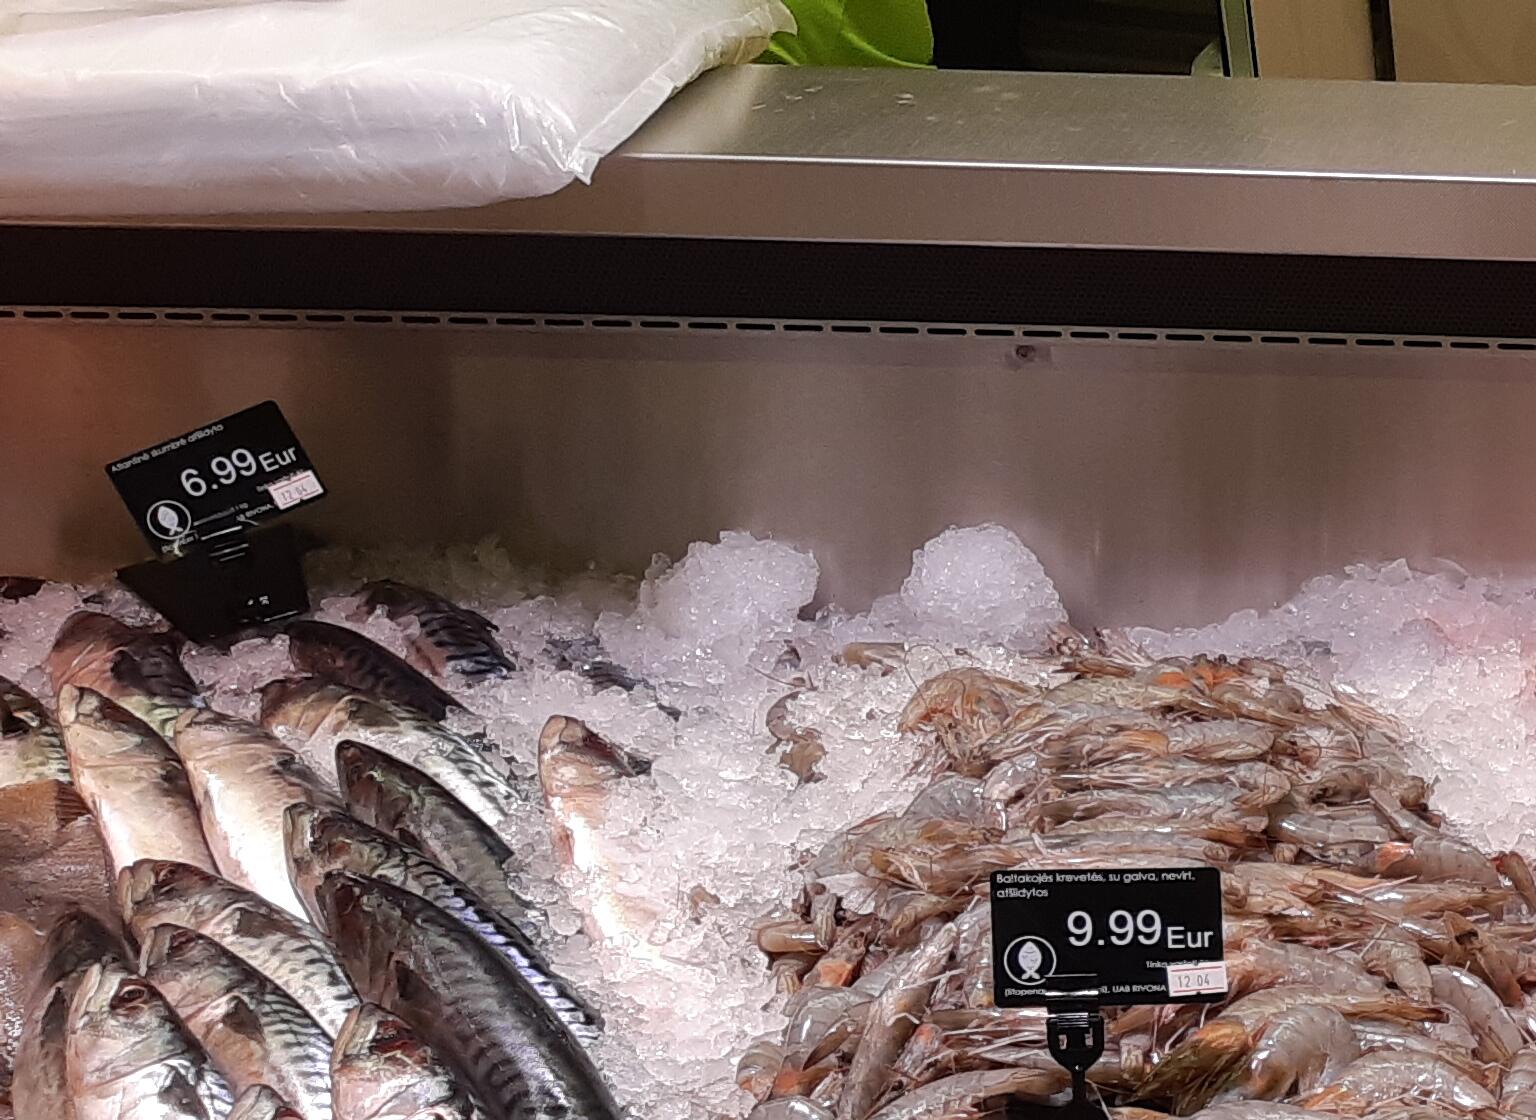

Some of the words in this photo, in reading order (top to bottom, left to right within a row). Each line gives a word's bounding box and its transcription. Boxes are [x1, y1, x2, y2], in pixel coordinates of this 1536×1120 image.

[180, 448, 257, 497] 6.99
[258, 446, 297, 472] Eur
[1109, 873, 1121, 882] su
[1067, 909, 1162, 947] 9.99
[1167, 926, 1214, 949] Eur
[1177, 975, 1192, 988] 12
[1197, 973, 1210, 987] 04
